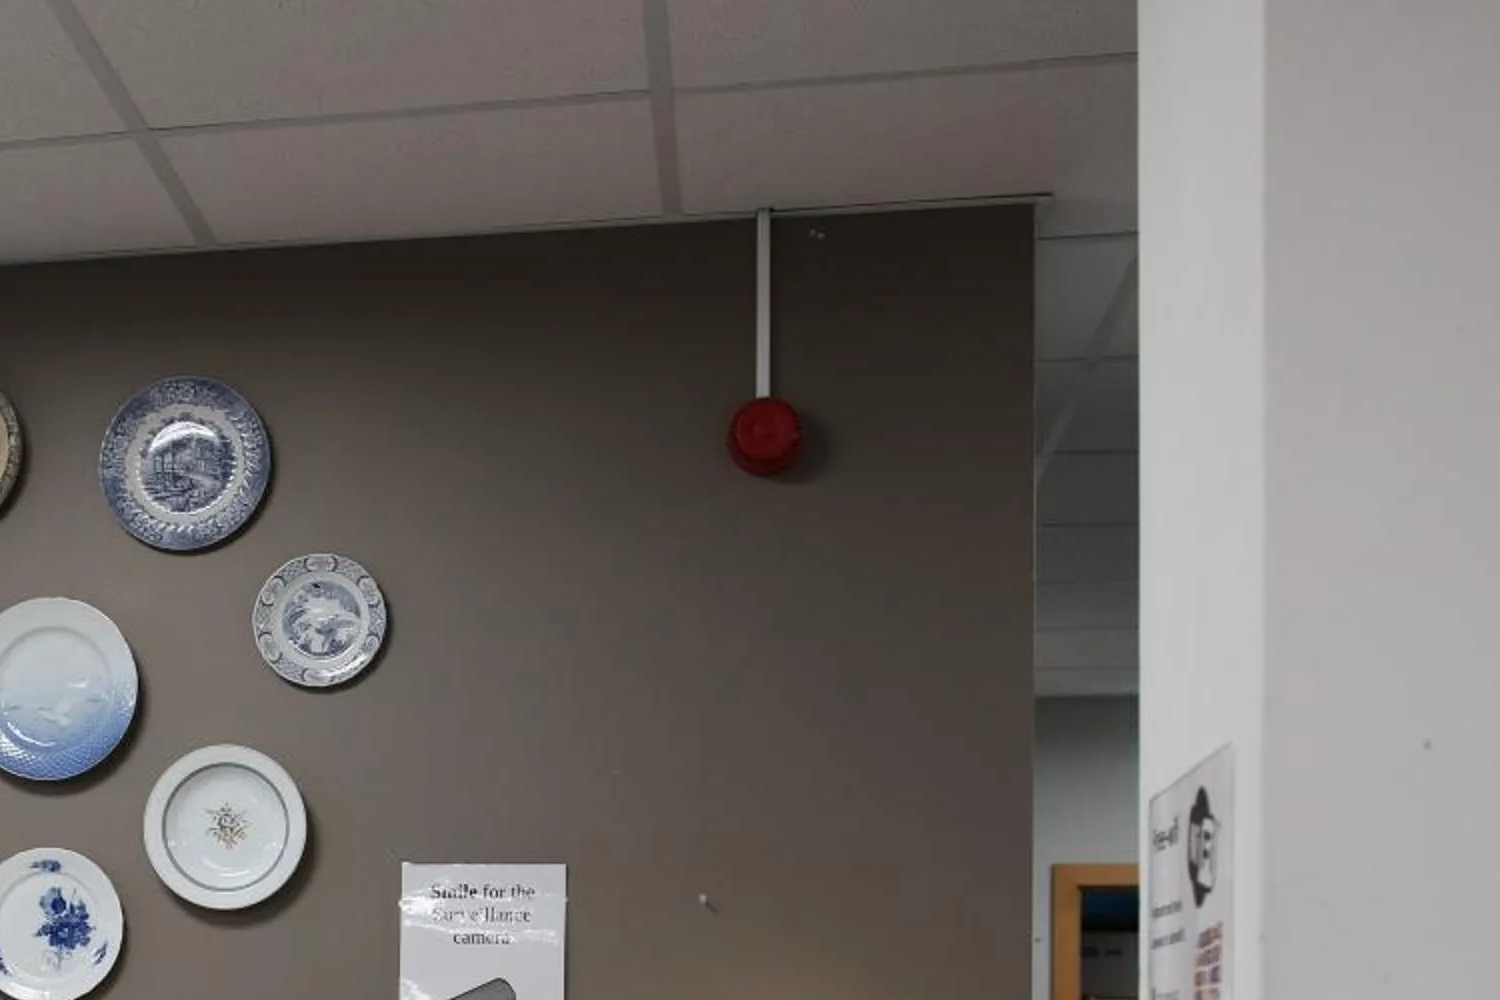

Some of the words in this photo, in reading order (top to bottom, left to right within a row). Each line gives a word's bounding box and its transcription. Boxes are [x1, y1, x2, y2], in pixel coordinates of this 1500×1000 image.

[431, 884, 478, 899] Smile
[483, 884, 506, 898] for
[511, 884, 536, 899] the
[453, 932, 512, 945] camera
